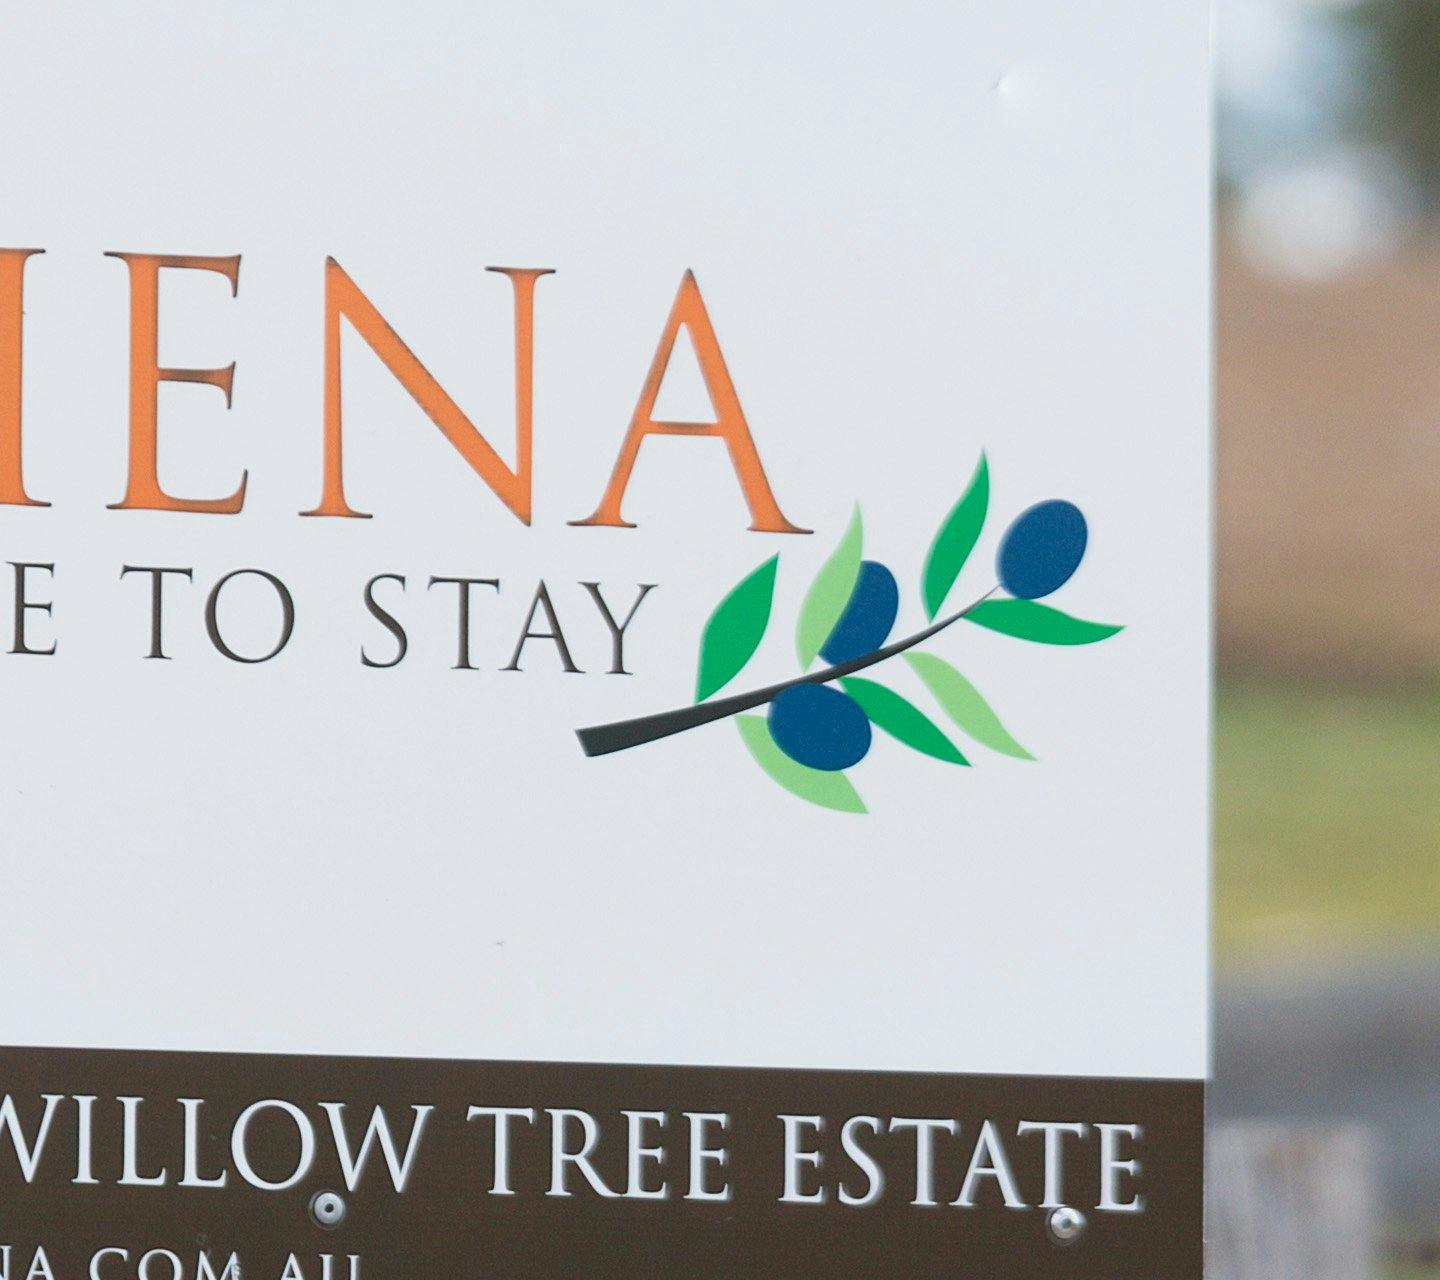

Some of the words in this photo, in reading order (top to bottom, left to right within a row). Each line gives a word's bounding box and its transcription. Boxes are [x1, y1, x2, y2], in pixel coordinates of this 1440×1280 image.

[119, 563, 297, 666] TO
[359, 572, 660, 677] STAY
[465, 1104, 732, 1203] TREE
[775, 1113, 1143, 1216] ESTATE
